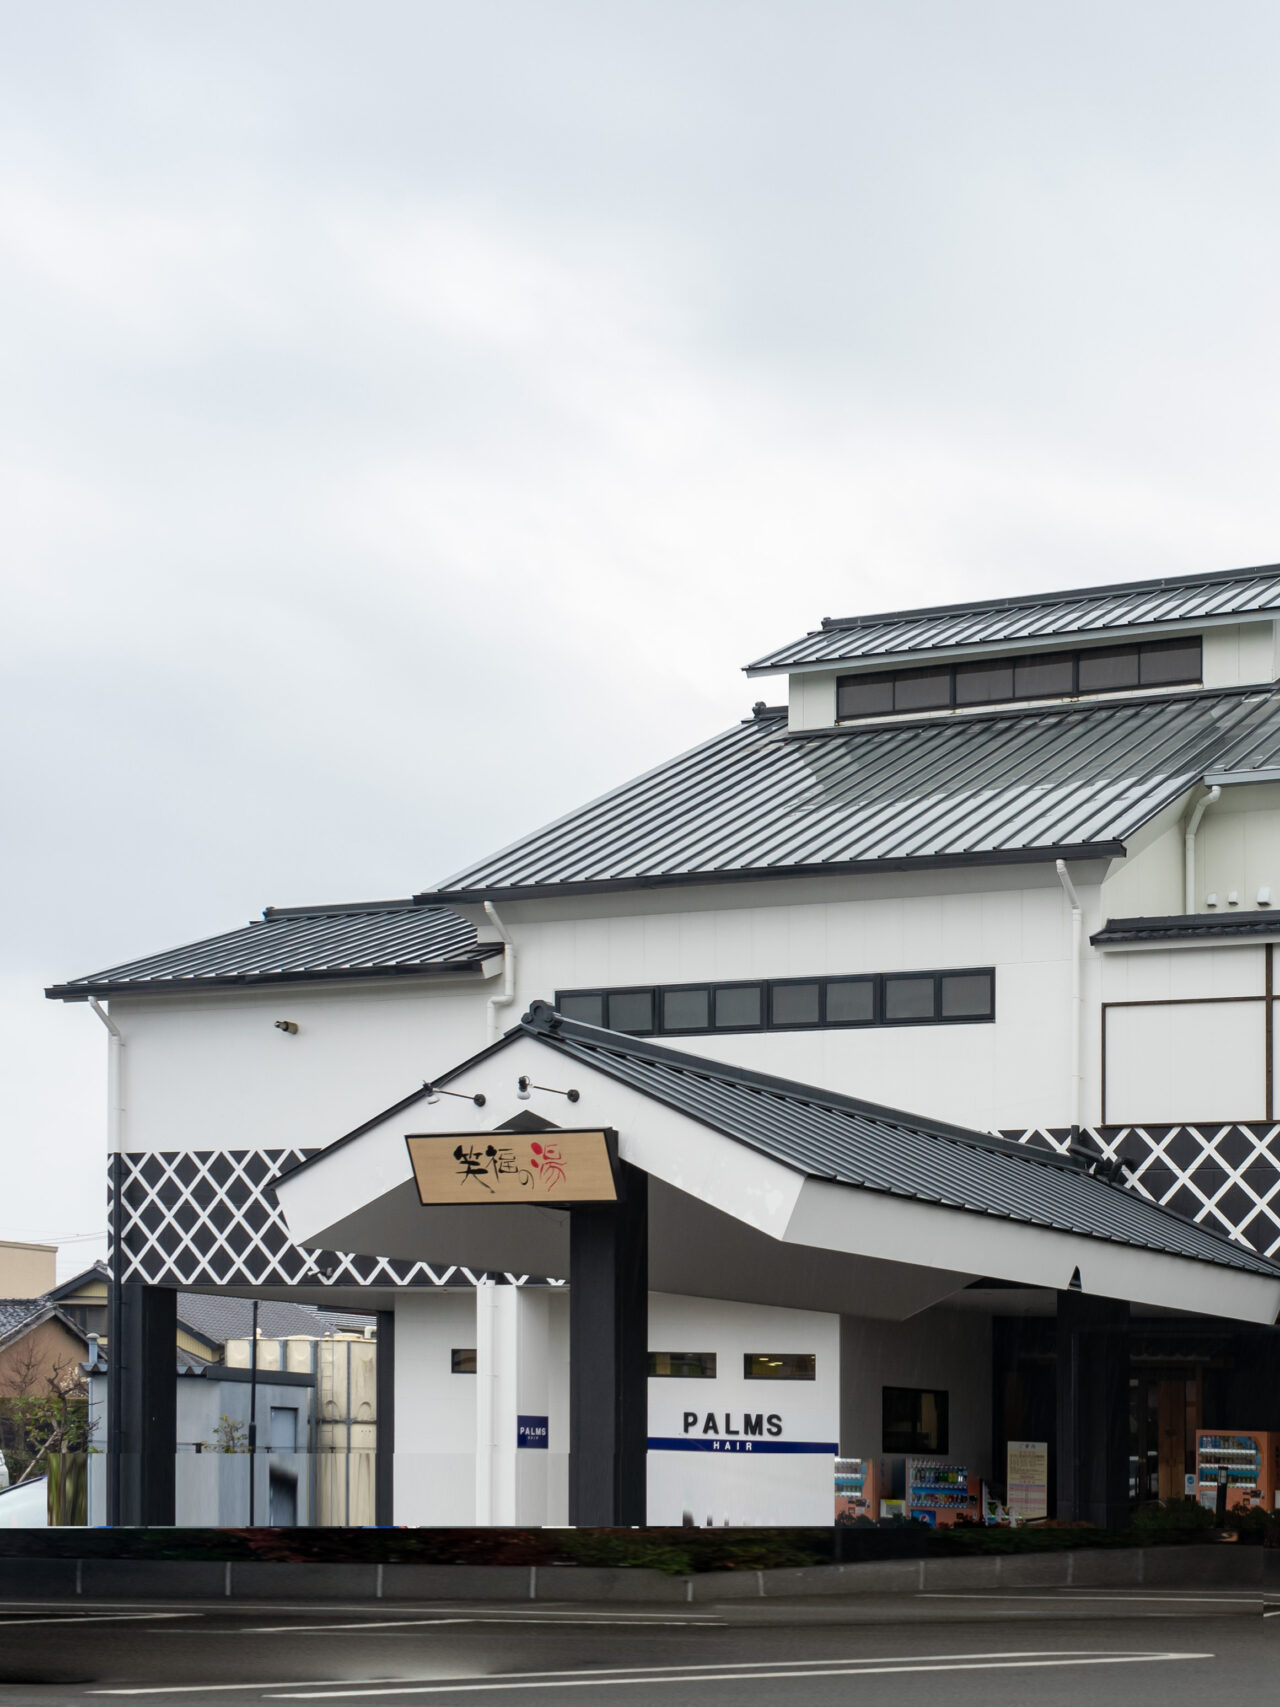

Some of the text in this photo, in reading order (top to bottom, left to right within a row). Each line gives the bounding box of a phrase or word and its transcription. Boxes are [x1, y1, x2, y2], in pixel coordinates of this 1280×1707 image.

[453, 1141, 568, 1194] 笑福の湯
[520, 1427, 546, 1435] PALMS
[683, 1411, 783, 1437] PALMS
[713, 1441, 753, 1451] HAIR
